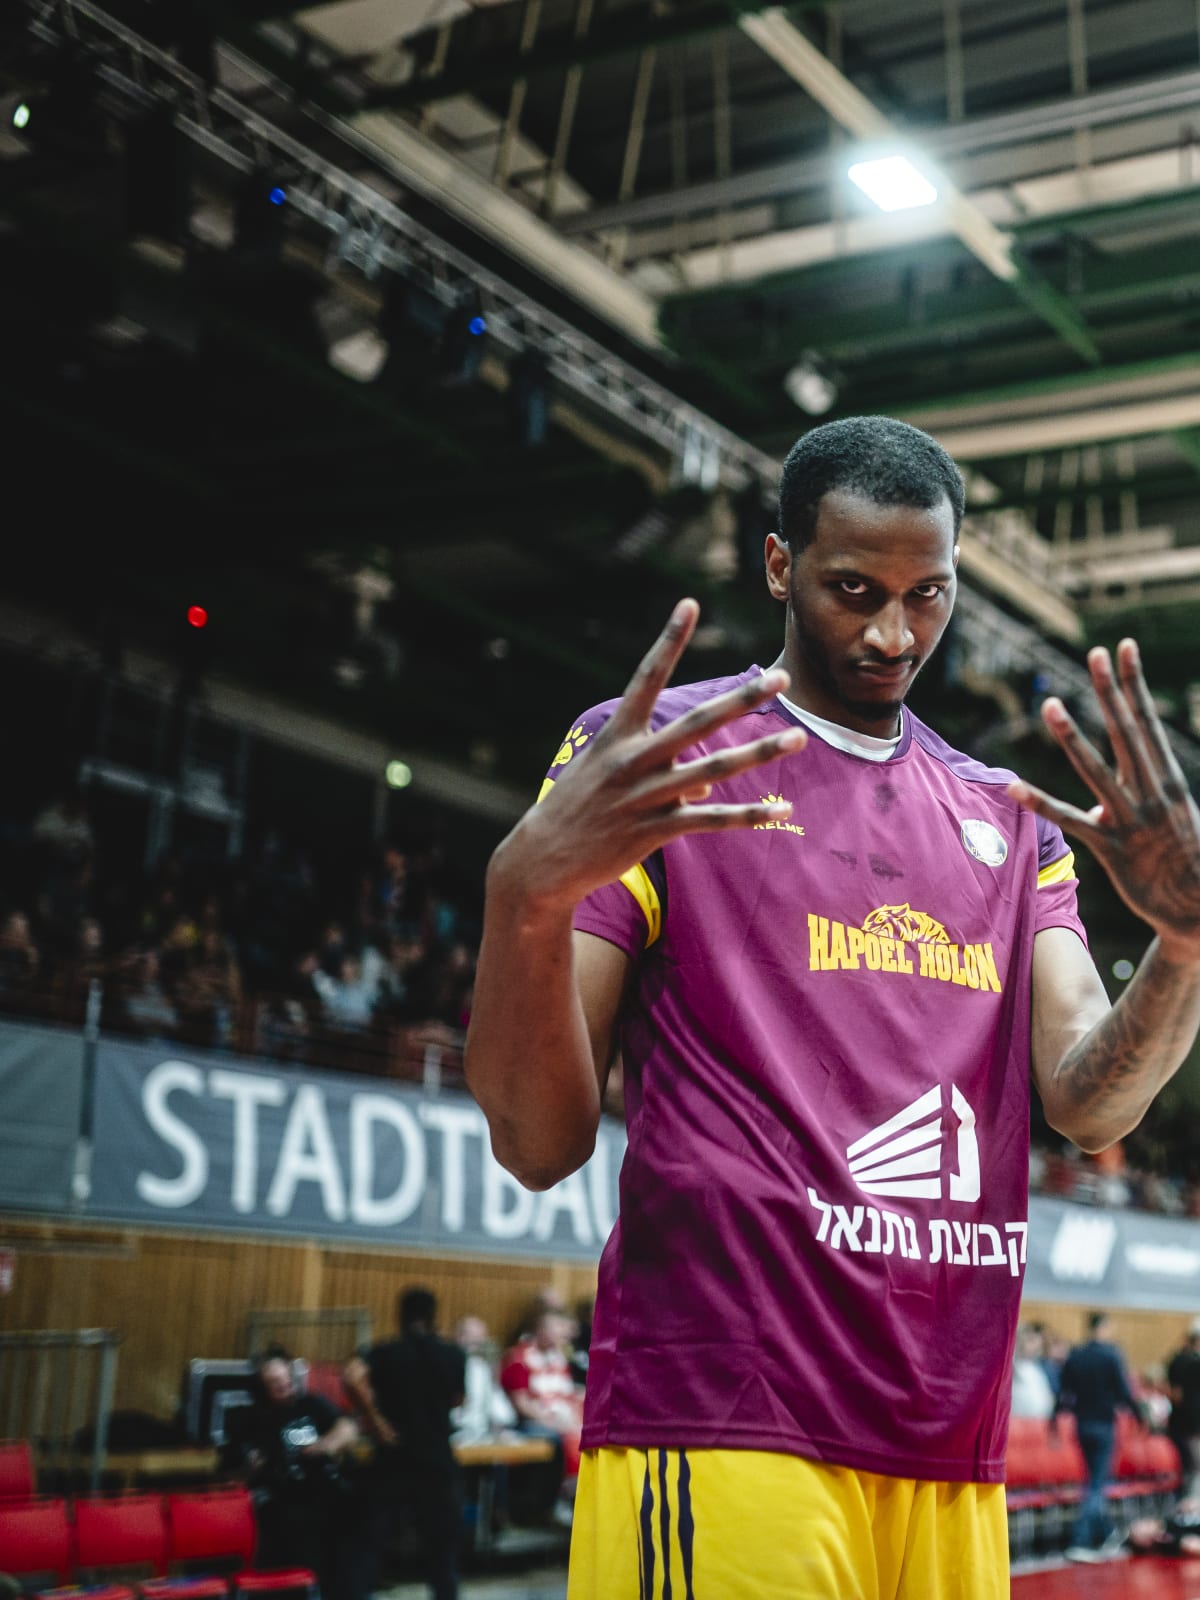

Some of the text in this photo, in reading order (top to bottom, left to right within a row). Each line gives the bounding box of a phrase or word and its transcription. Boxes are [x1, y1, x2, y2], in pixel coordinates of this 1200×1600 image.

[807, 913, 1002, 993] HAPOEL HOLON
[807, 1187, 1028, 1277] קבוצת נתנאל
